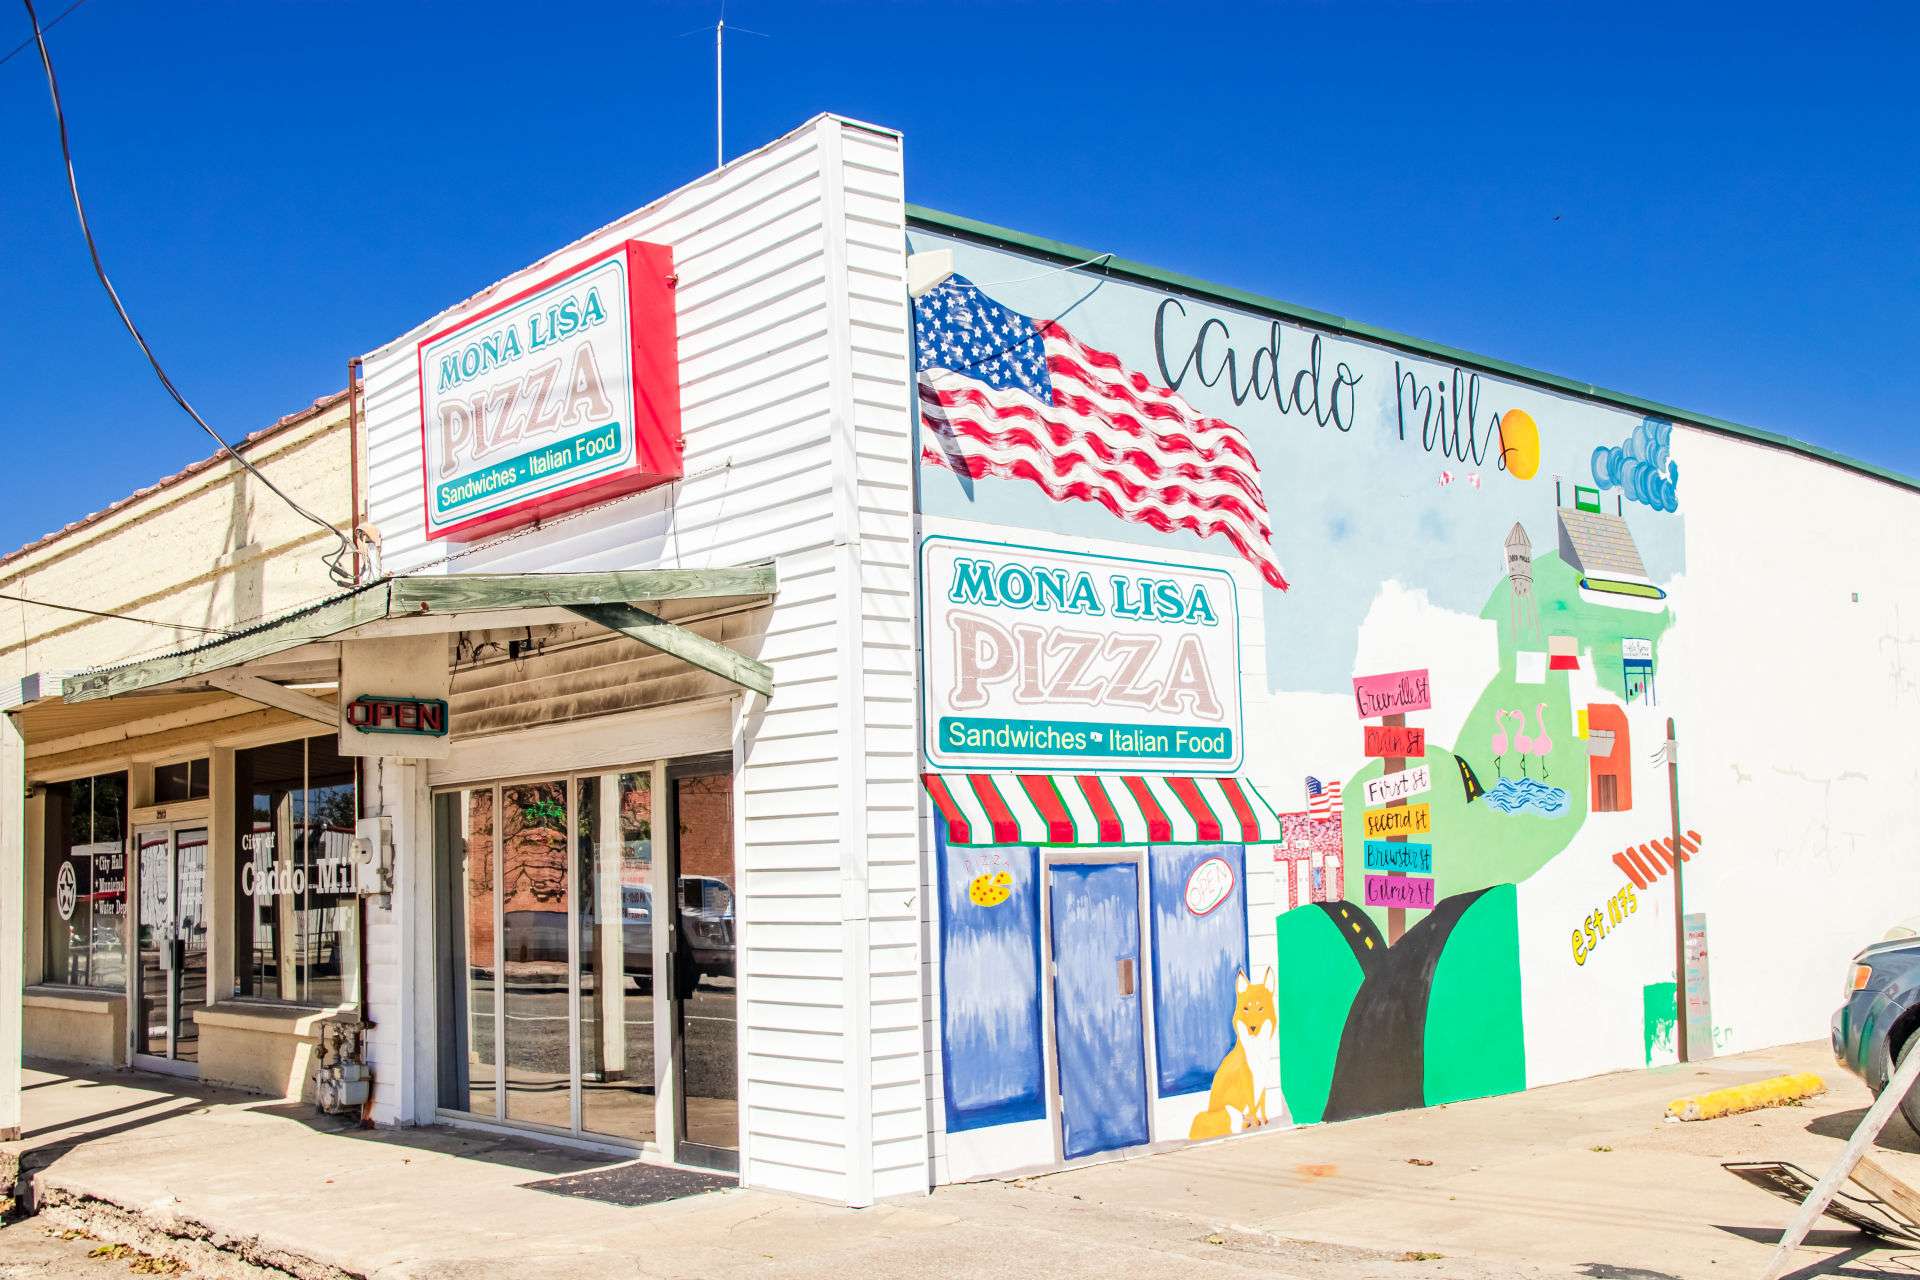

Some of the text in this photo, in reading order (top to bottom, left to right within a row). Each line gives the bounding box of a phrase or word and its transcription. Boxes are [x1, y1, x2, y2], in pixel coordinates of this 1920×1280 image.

[437, 287, 607, 394] MONA LISA
[1154, 298, 1363, 432] Caddo
[437, 341, 613, 479] PIZZA
[441, 466, 517, 506] Sandwiches
[530, 449, 572, 476] Italian
[576, 430, 616, 461] Food
[948, 557, 1218, 626] MONA LISA
[946, 608, 1224, 722] PIZZA
[1356, 677, 1416, 716] Greenville
[347, 701, 444, 732] OPEN
[949, 721, 1225, 753] Sandwiches Italian Food
[1368, 774, 1408, 802] First
[242, 832, 276, 852] City of
[1367, 844, 1417, 868] Brewster
[99, 854, 123, 874] City Hall
[242, 859, 305, 897] Caddo
[316, 857, 357, 894] Mil
[1368, 878, 1413, 904] Gilmer
[99, 899, 128, 919] Water Dep
